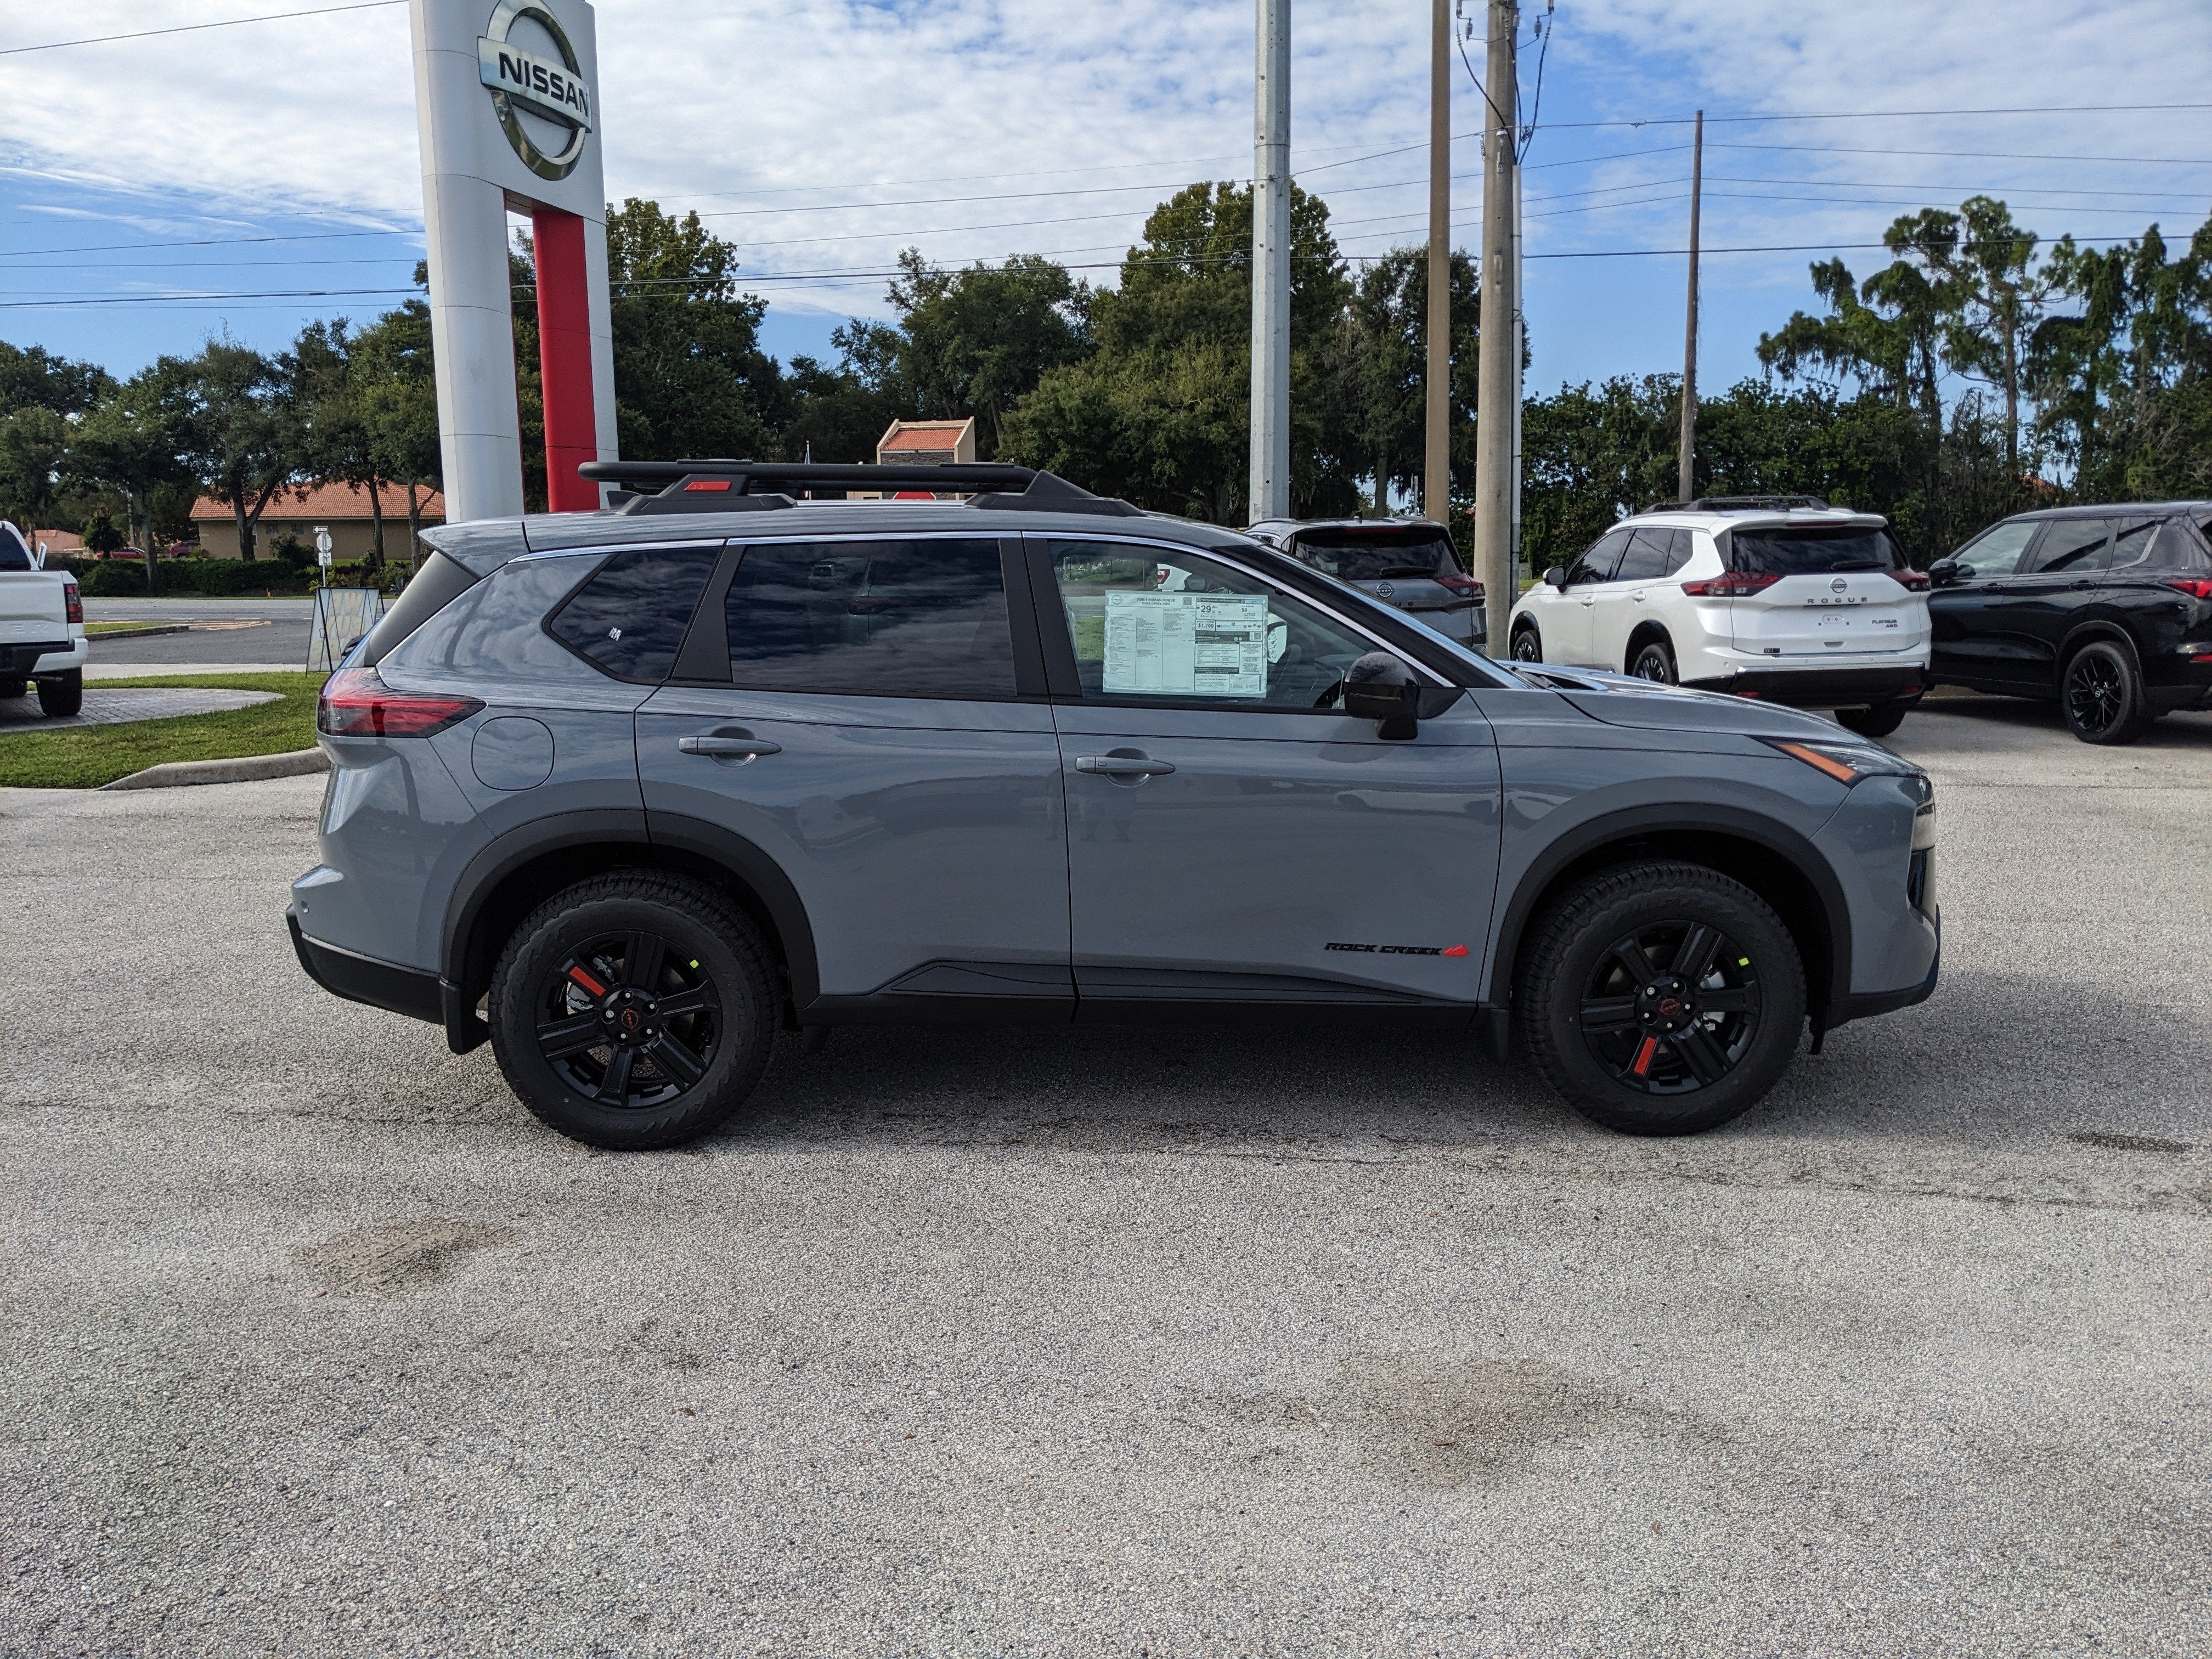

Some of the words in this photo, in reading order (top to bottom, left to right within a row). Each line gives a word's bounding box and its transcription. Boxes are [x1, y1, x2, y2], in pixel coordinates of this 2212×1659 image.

[498, 52, 589, 118] NISSAN
[1201, 605, 1211, 613] 29
[1324, 942, 1378, 952] ROCK
[1379, 945, 1443, 956] CREEK
